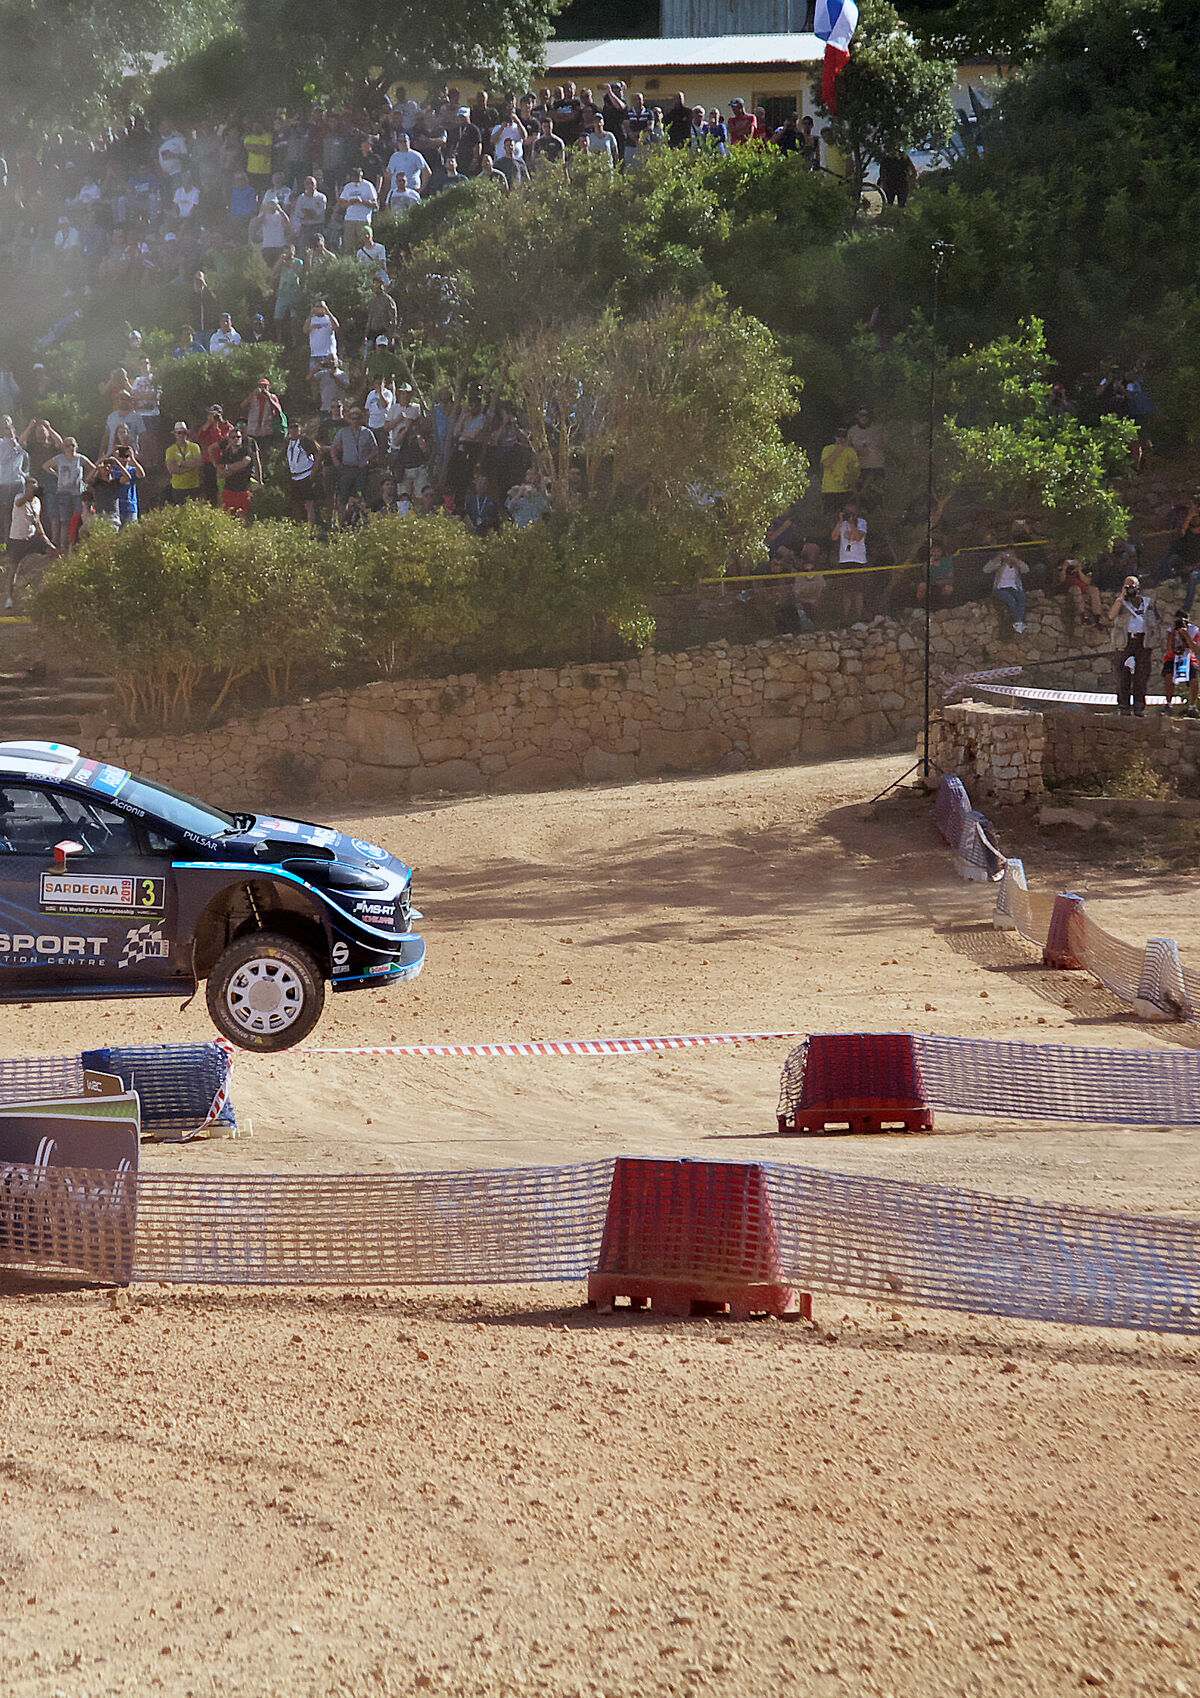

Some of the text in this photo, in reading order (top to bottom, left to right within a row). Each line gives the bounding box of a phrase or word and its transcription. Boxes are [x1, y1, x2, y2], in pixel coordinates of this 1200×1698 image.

[111, 798, 145, 817] Acronis
[183, 831, 218, 851] PULSAR
[45, 883, 119, 895] SARDEGNA
[121, 880, 131, 902] 2019
[141, 880, 156, 906] 3
[47, 957, 106, 967] CENTRE
